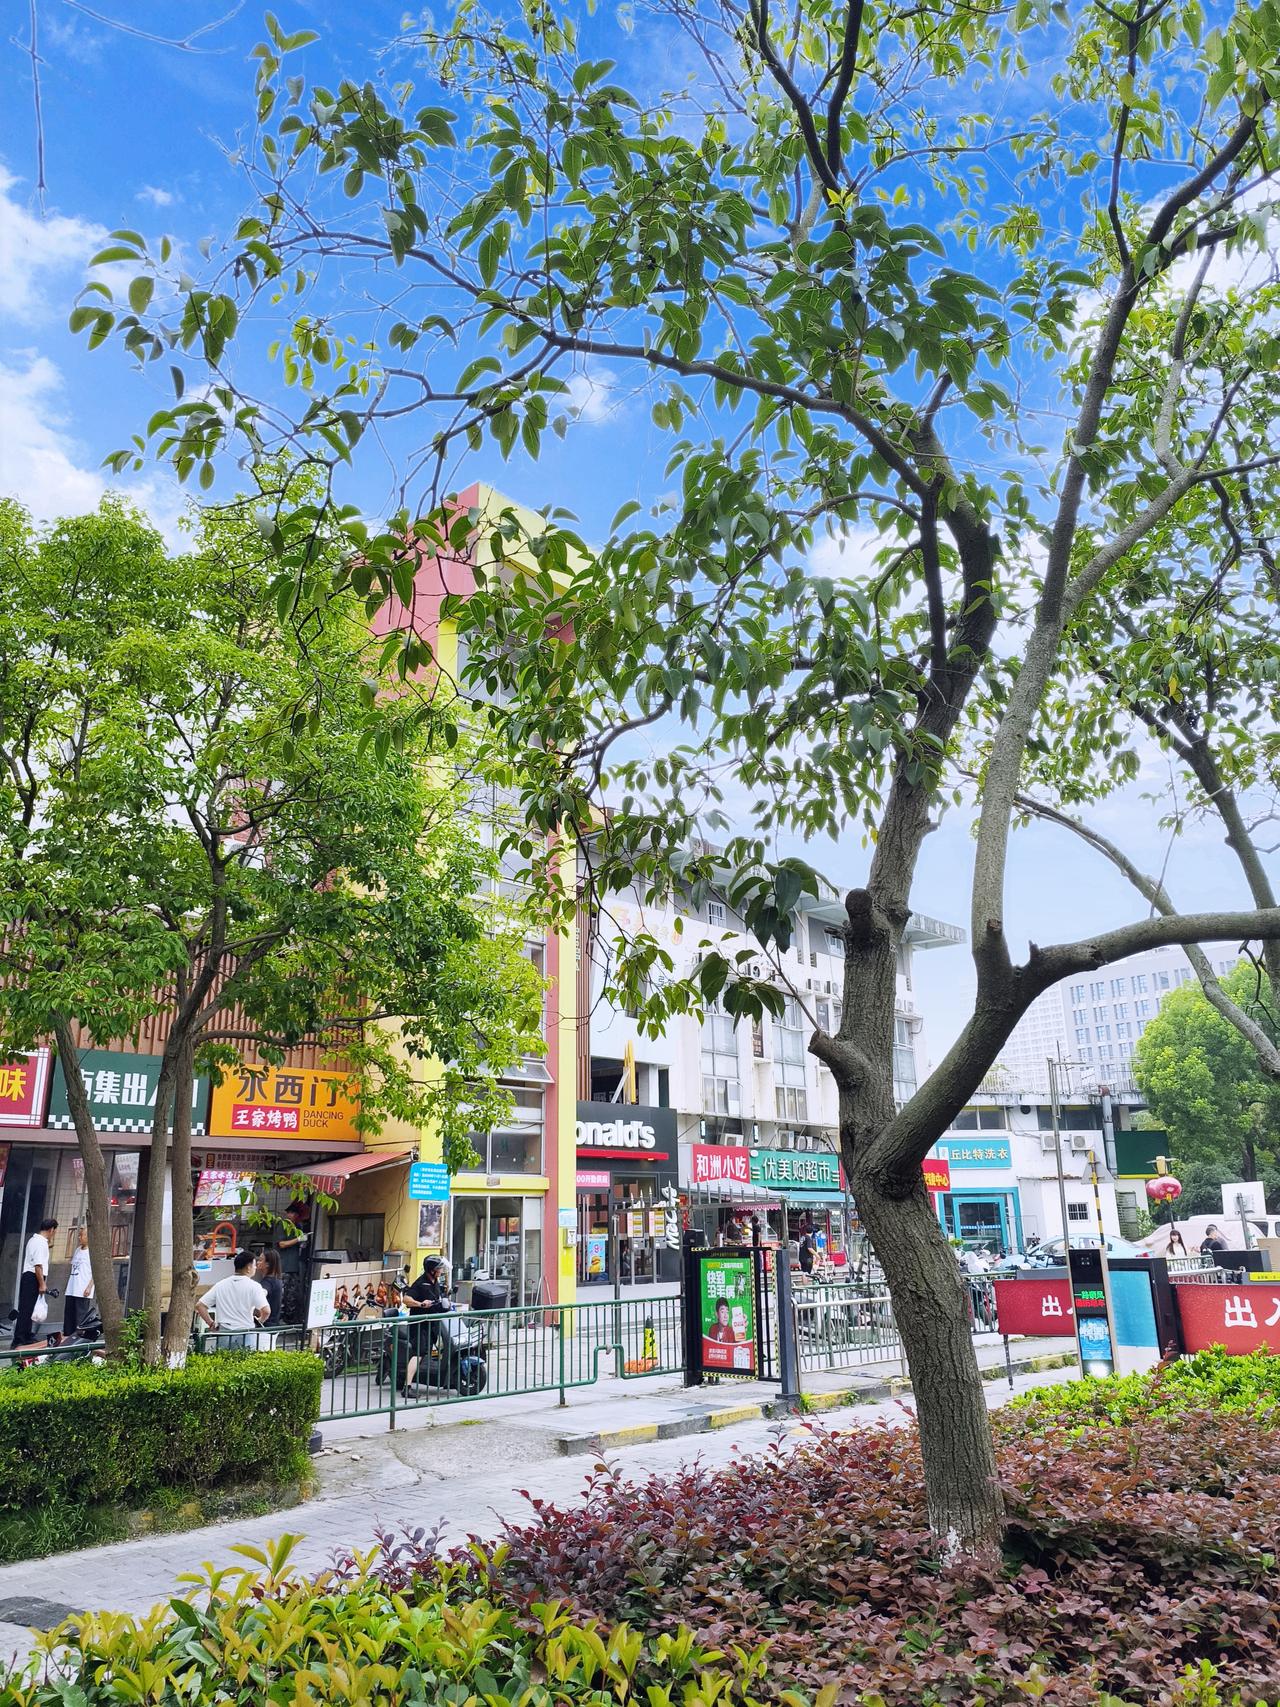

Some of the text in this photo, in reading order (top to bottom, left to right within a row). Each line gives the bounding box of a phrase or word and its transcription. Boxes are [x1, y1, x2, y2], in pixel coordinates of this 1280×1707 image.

[236, 1069, 338, 1107] 水西门
[234, 1107, 298, 1129] 王家烤鸭
[303, 1110, 344, 1120] DANCING
[303, 1118, 329, 1128] DUCK
[950, 1147, 1009, 1161] 丘比特洗衣
[696, 1154, 747, 1180] 和洲小吃
[762, 1157, 830, 1182] 优美购超市
[1041, 1294, 1075, 1317] 出
